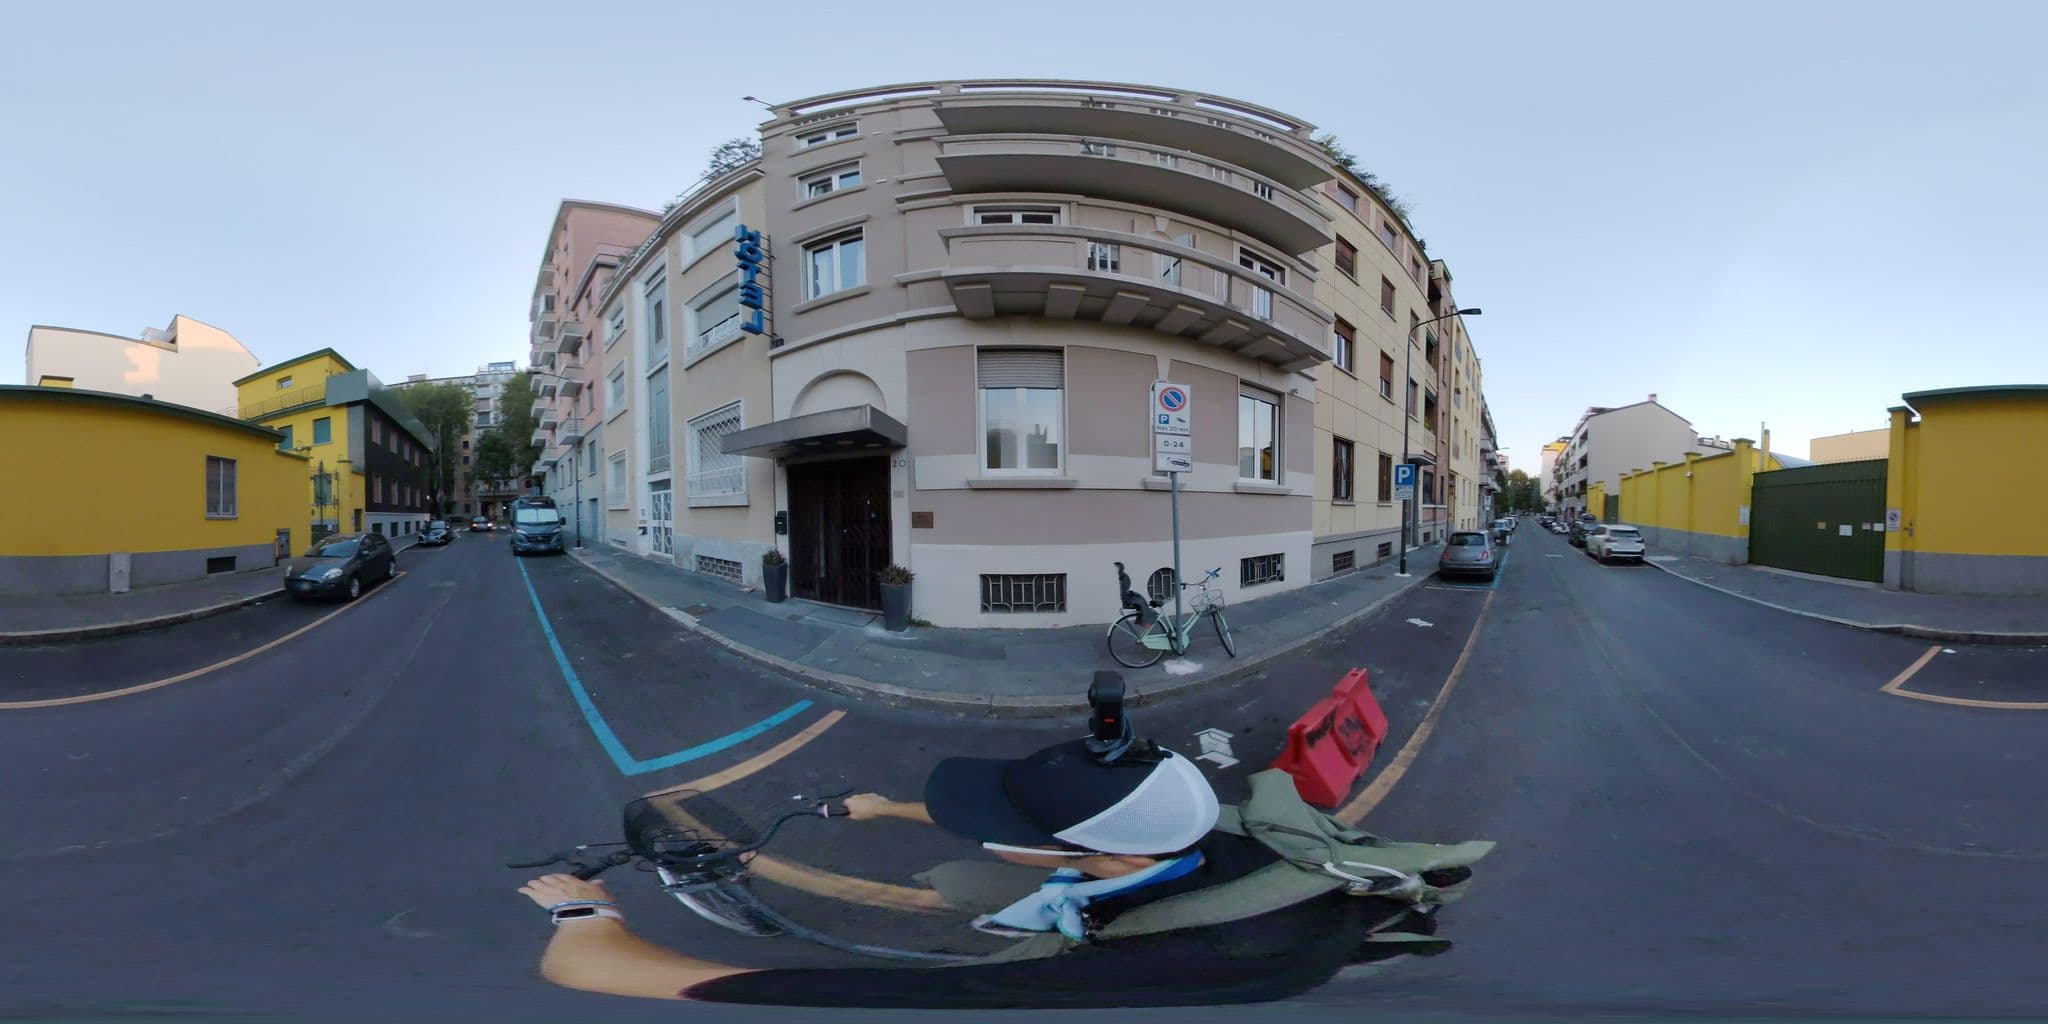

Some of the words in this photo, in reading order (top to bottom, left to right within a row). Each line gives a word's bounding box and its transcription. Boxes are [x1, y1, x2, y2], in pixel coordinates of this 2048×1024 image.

[734, 223, 764, 335] HOTEL
[1160, 415, 1168, 423] P
[1163, 440, 1184, 448] 0-24
[892, 459, 907, 467] 20
[1398, 466, 1411, 484] P
